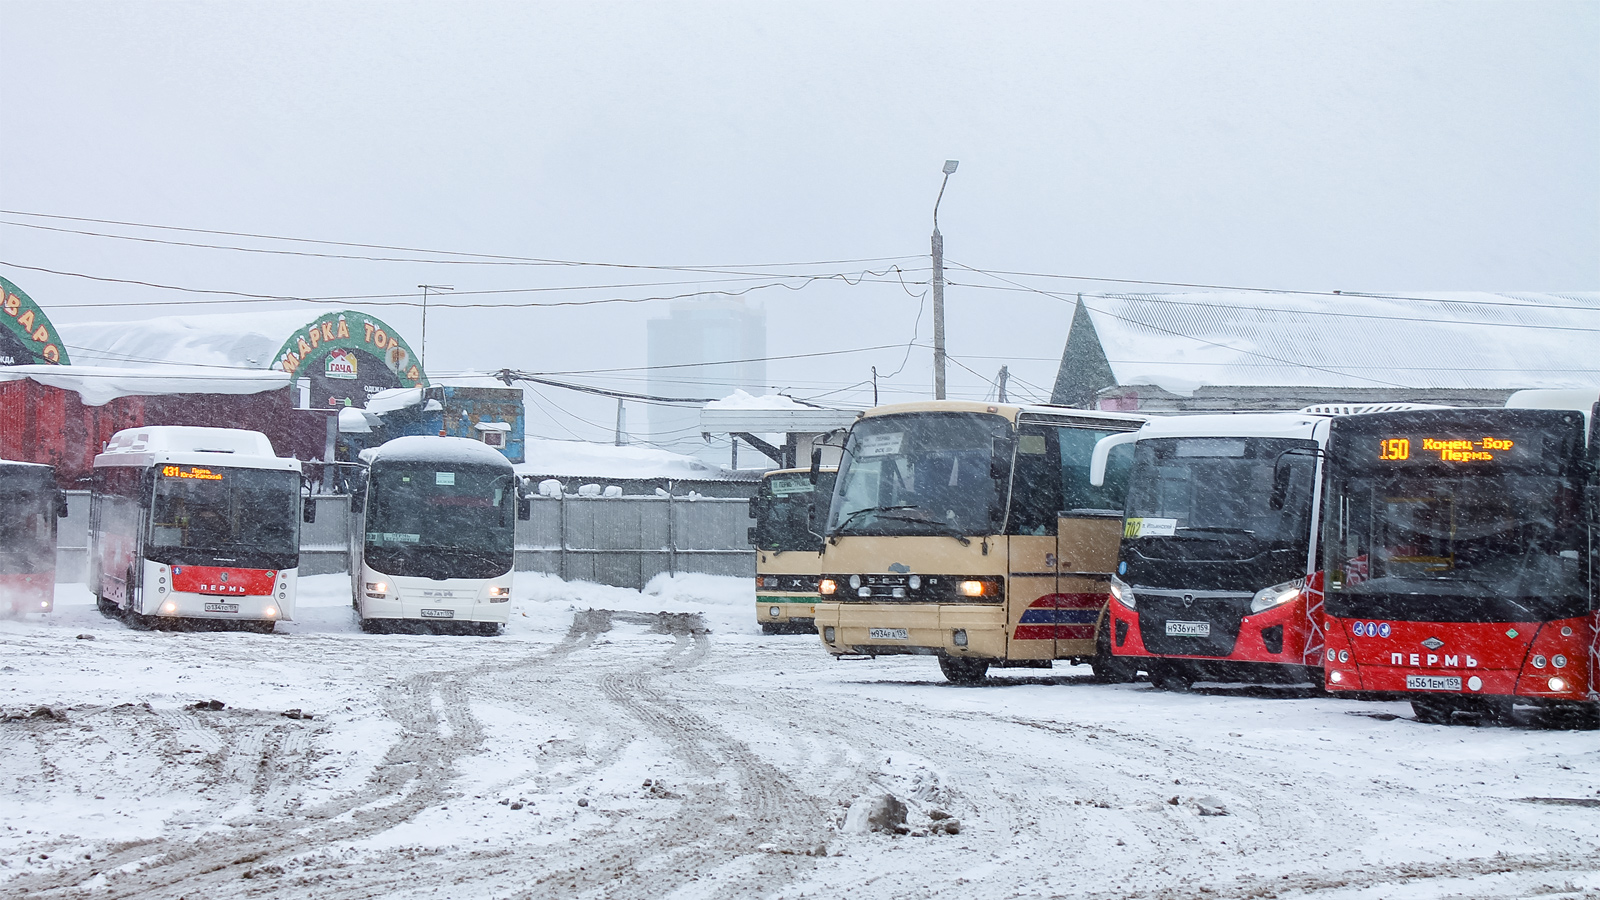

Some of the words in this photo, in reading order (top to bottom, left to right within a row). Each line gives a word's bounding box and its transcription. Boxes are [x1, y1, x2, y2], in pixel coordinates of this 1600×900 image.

[330, 363, 352, 373] ГАЧА
[1379, 438, 1410, 460] 150
[1441, 449, 1493, 462] Пермь
[162, 466, 180, 477] 431
[1125, 521, 1142, 538] 702
[868, 577, 938, 585] SETA
[200, 584, 246, 593] ПЕРМЬ
[871, 629, 896, 638] М934РА
[1167, 624, 1196, 633] Н936УН
[1197, 624, 1209, 632] 159
[1391, 652, 1478, 668] ПЕРМЬ
[1408, 678, 1444, 688] Н561ЕМ
[1446, 678, 1459, 687] 159
